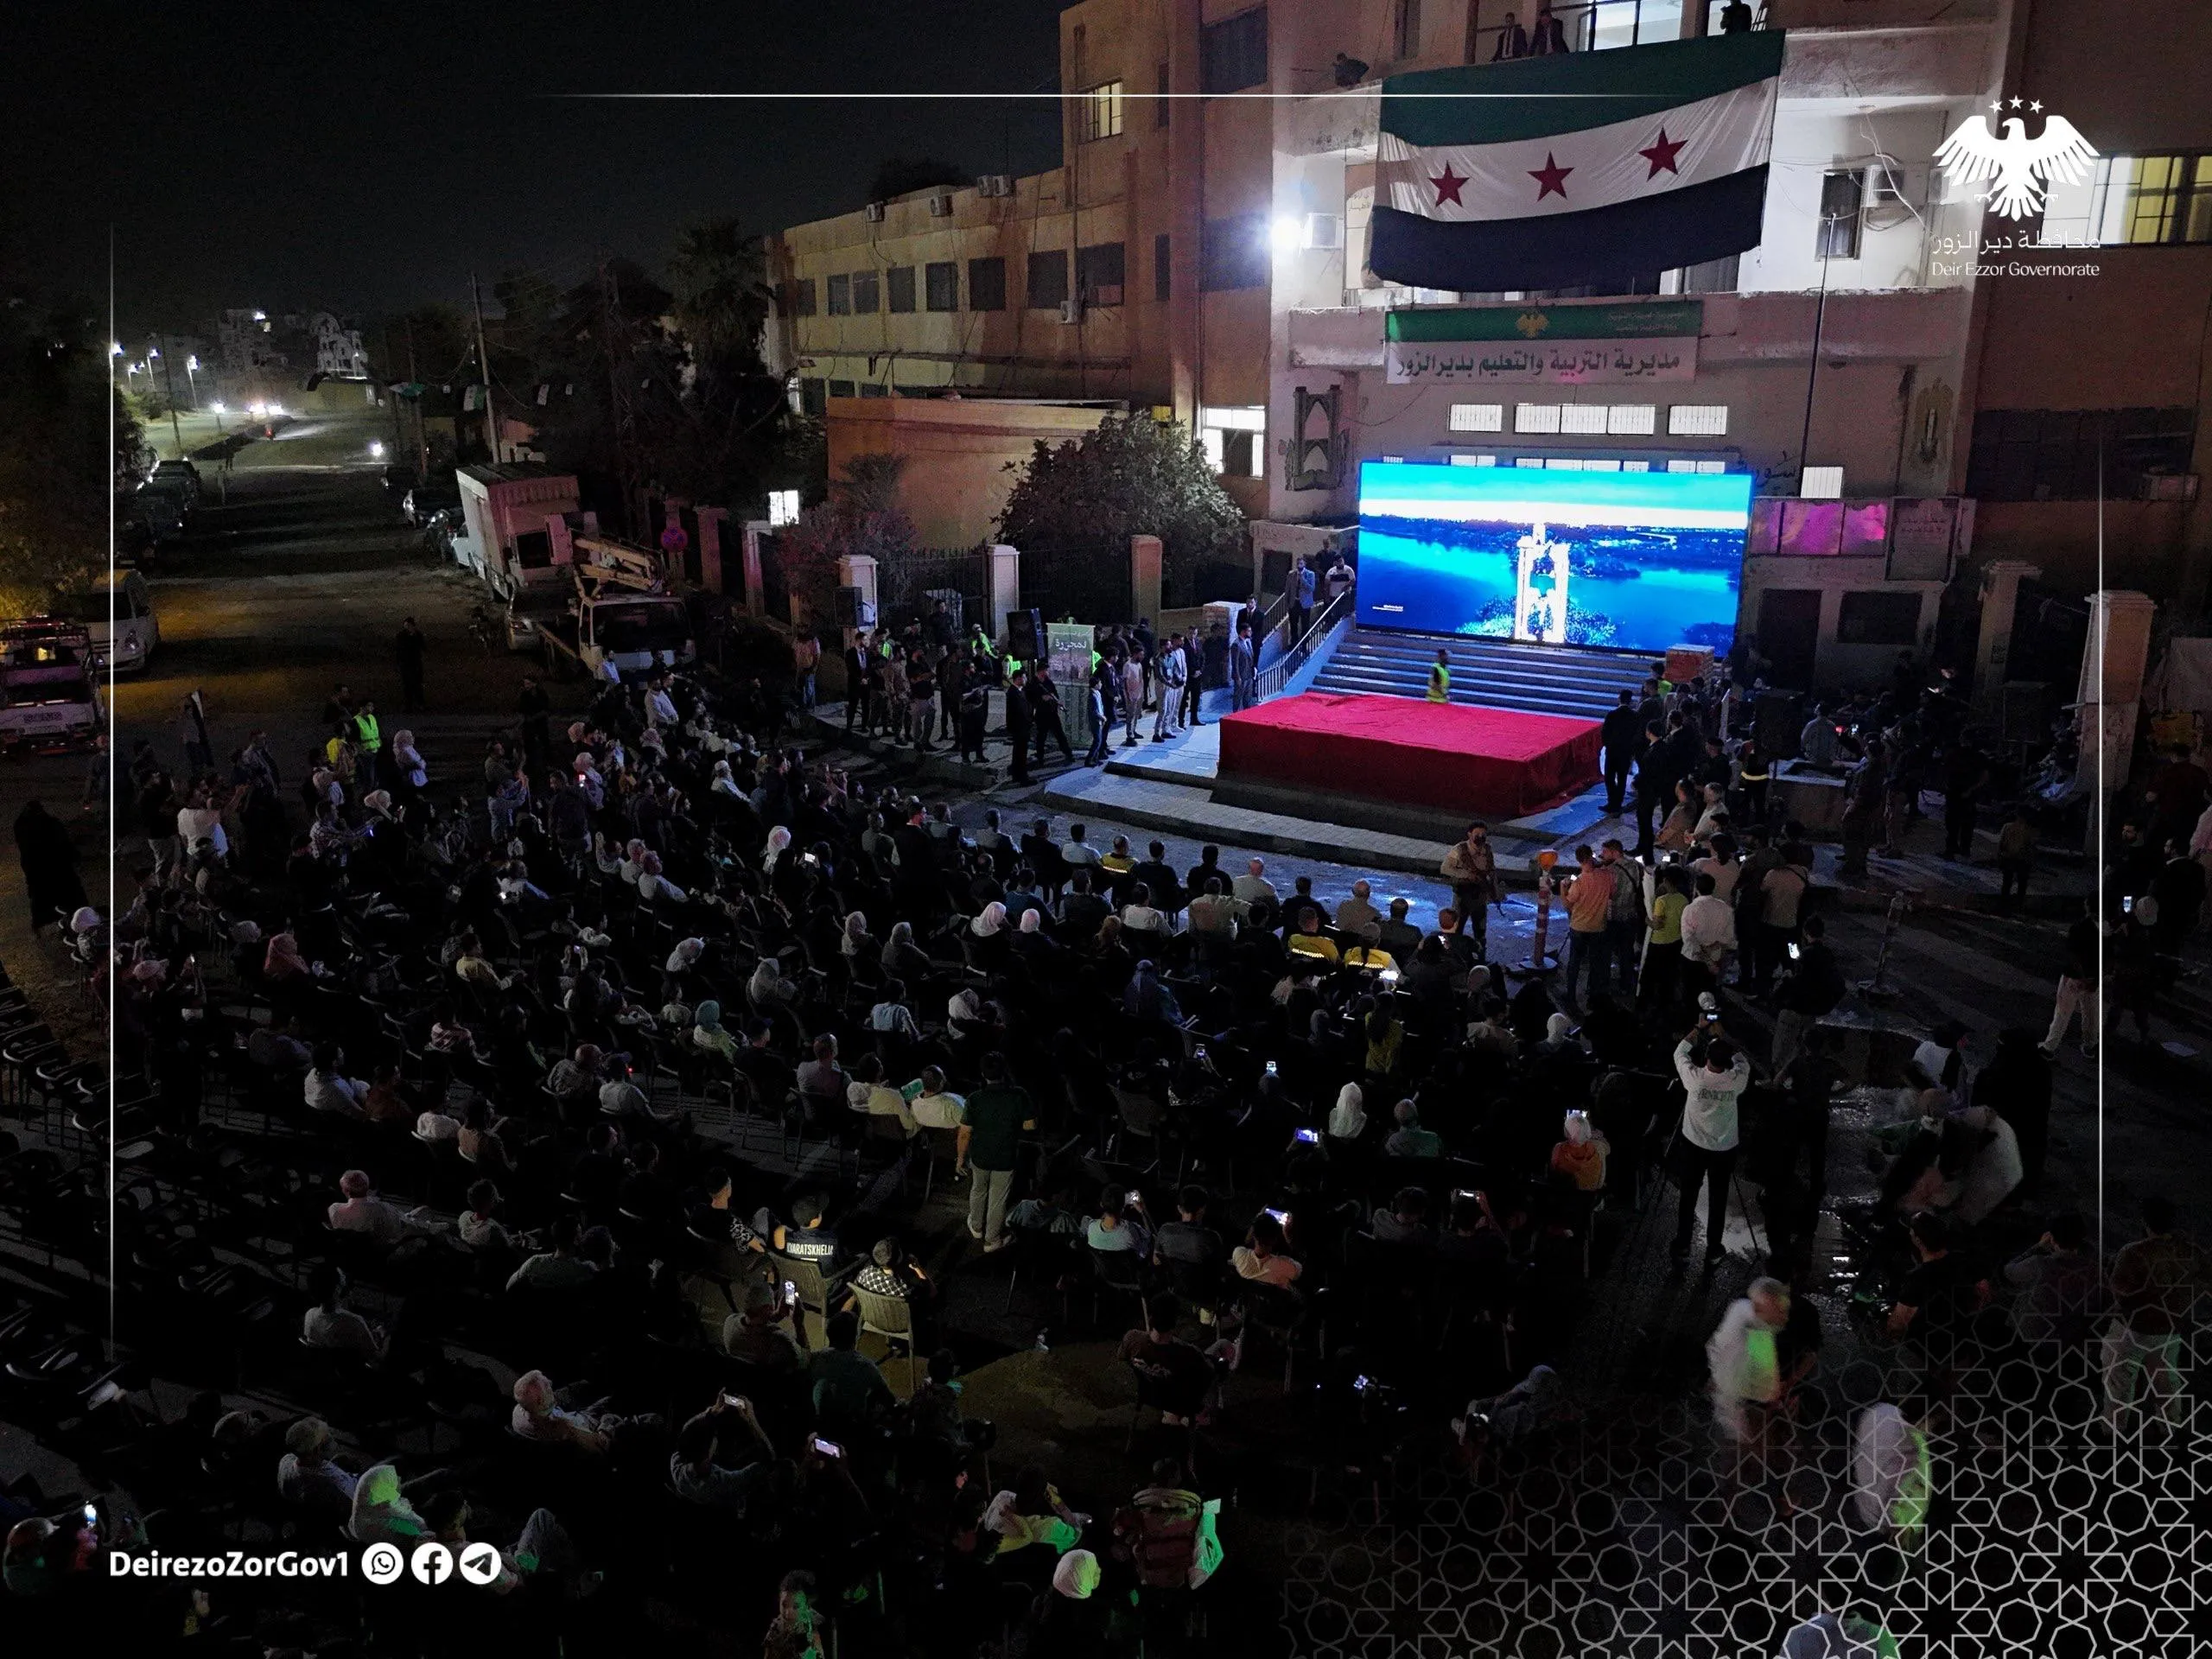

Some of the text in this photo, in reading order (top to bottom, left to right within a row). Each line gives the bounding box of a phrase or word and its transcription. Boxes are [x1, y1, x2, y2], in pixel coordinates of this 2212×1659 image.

[1478, 350, 1544, 378] والتعليم
[1550, 348, 1608, 378] التربية
[1614, 347, 1680, 377] مديرية
